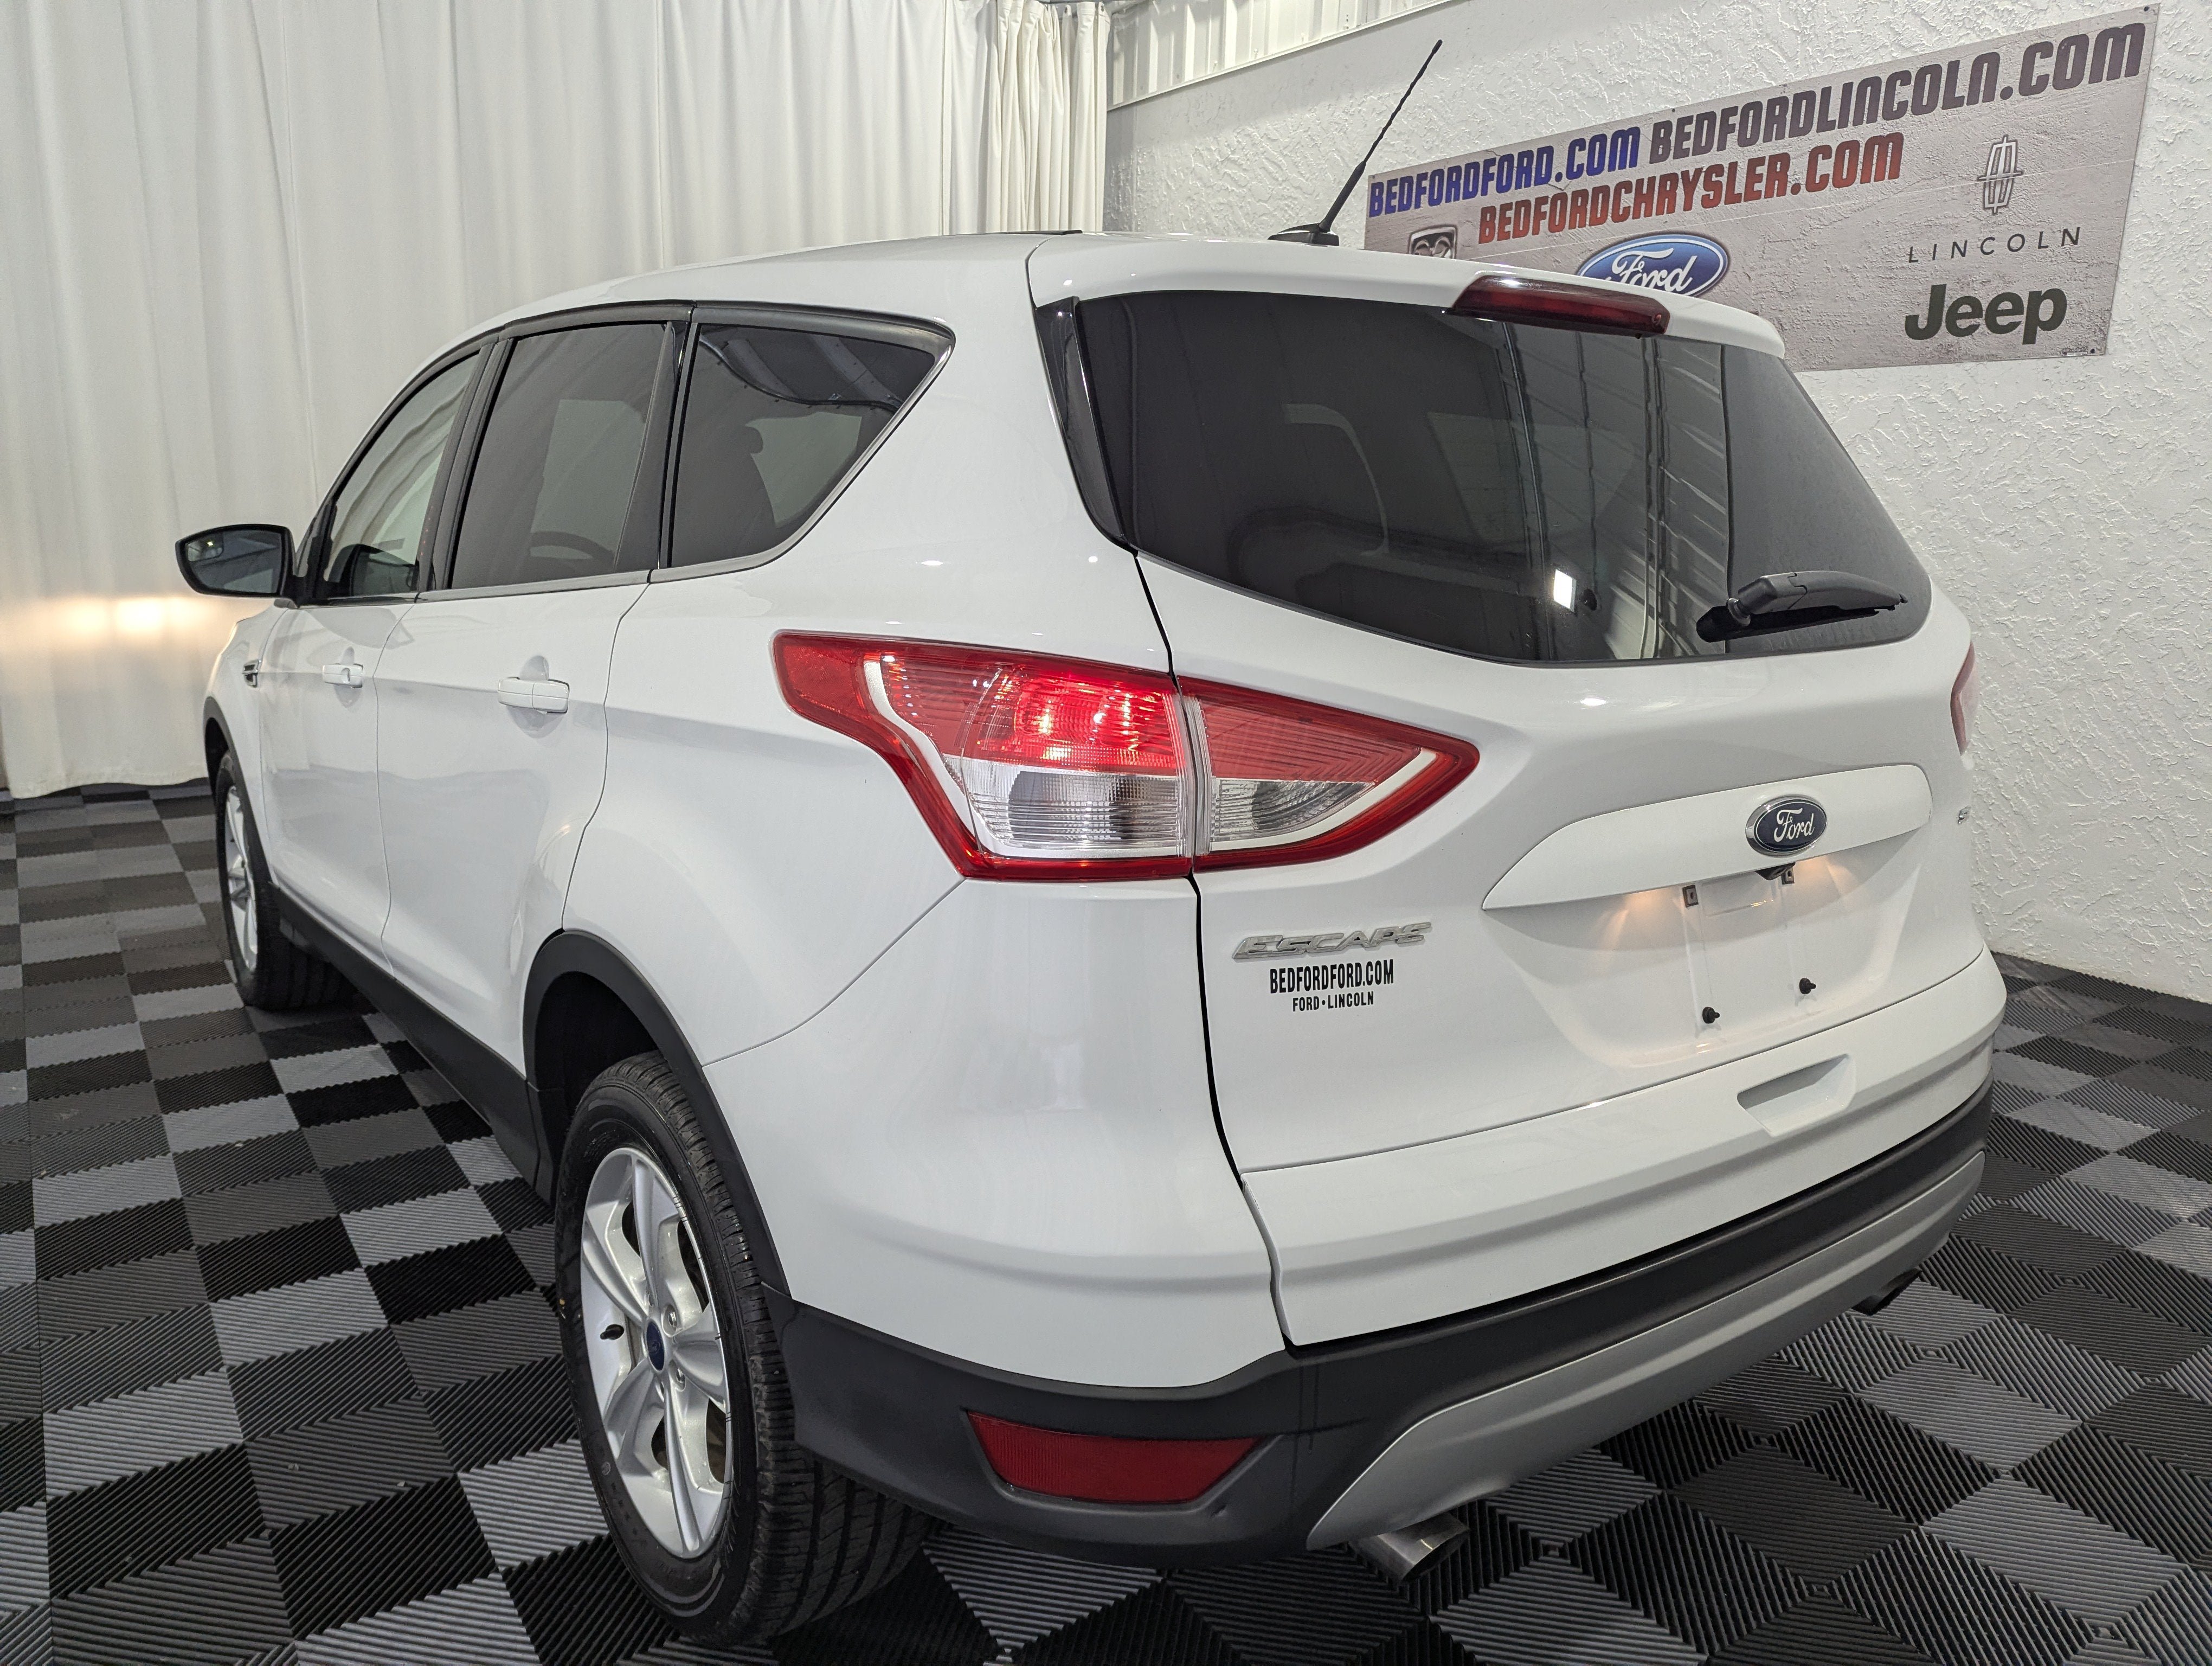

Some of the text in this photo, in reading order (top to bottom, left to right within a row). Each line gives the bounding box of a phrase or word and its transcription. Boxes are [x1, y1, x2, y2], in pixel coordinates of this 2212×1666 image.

[1369, 22, 2145, 217] BEDFORDFORD.COM BEDFORDLINCOLN.COM
[1478, 132, 1903, 244] BEDFORDCHRYSLER.COM
[1908, 227, 2080, 263] LINCOLN
[1904, 284, 2067, 345] Jeep
[1773, 808, 1815, 842] Ford
[1232, 922, 1432, 960] ESCAPE
[1270, 959, 1394, 994] BEDFORDFORD.COM
